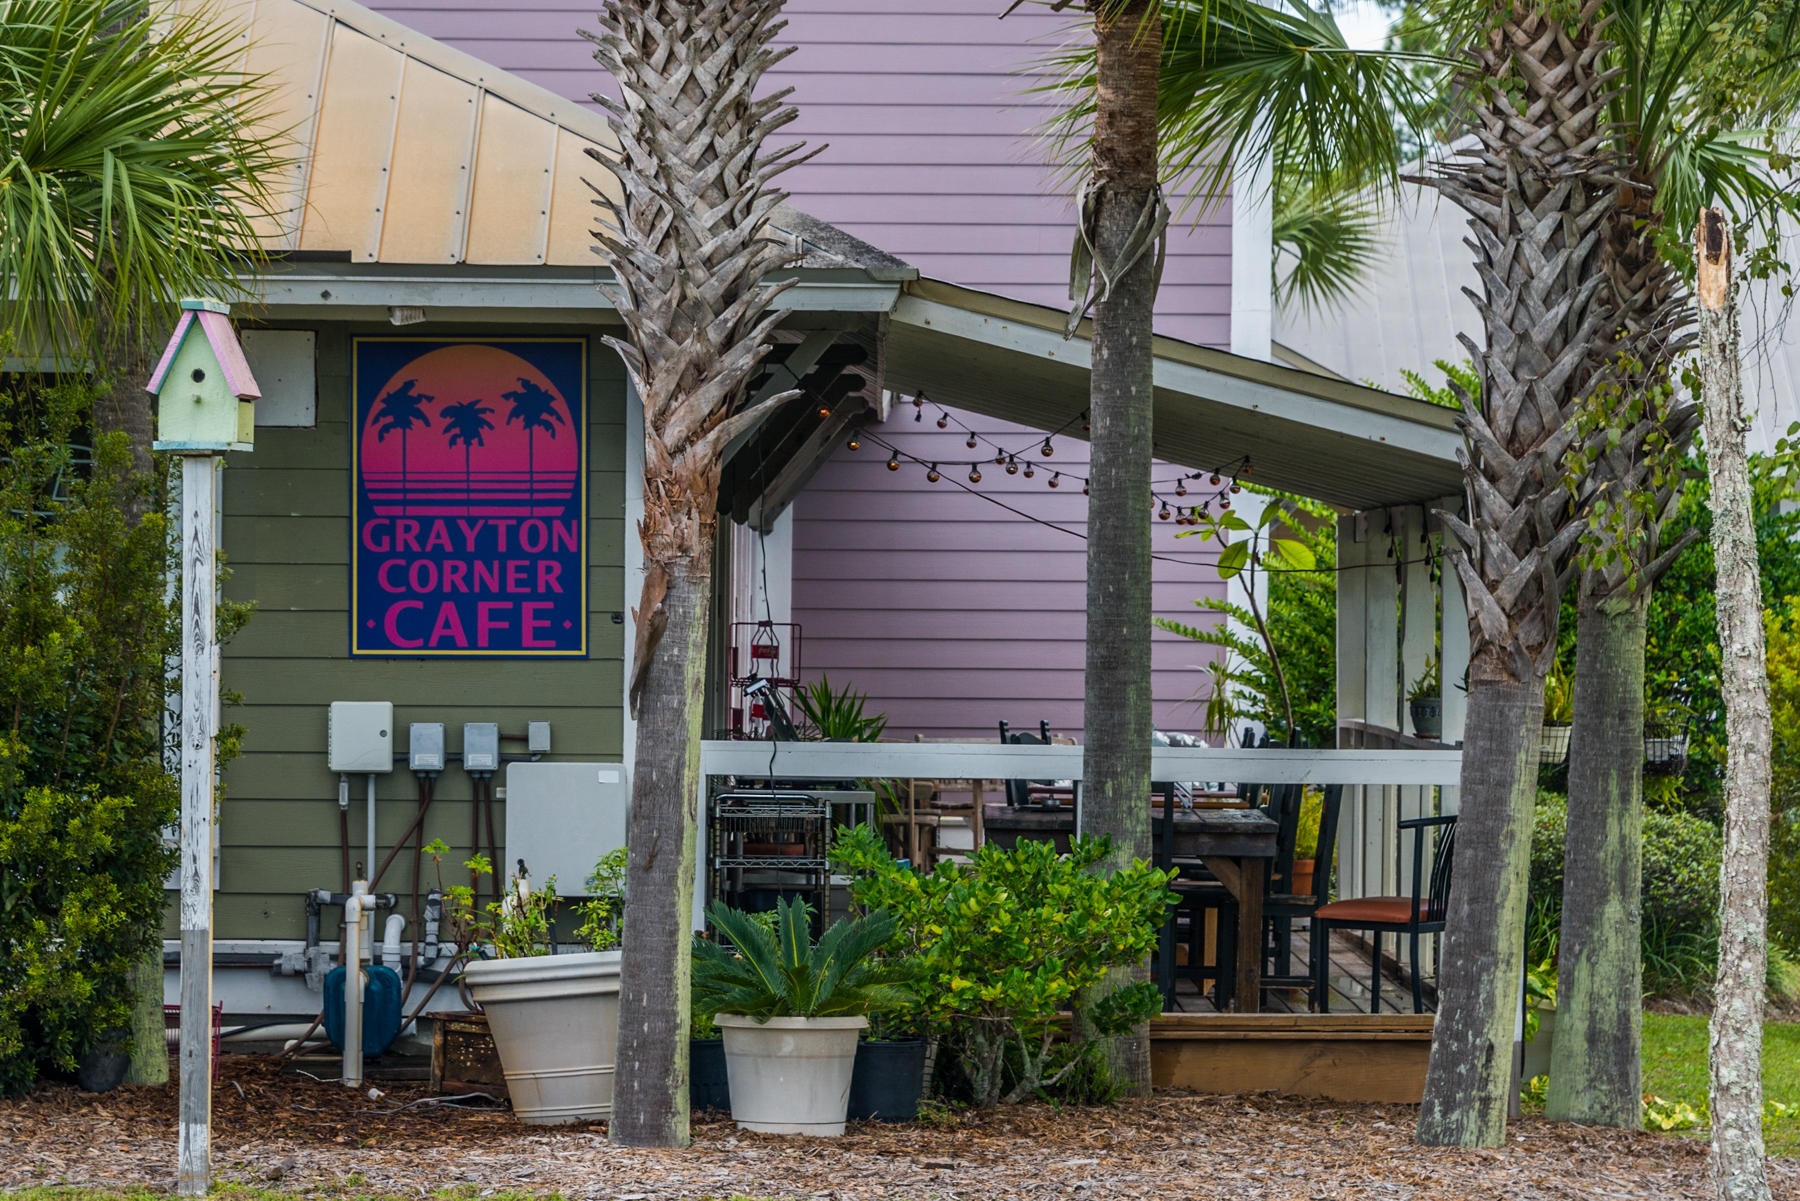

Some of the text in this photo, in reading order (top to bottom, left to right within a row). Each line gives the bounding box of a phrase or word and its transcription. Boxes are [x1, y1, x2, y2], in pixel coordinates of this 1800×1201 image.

[362, 518, 578, 553] GRAYTON
[378, 559, 564, 593] CORNER
[384, 600, 556, 648] CAFE
